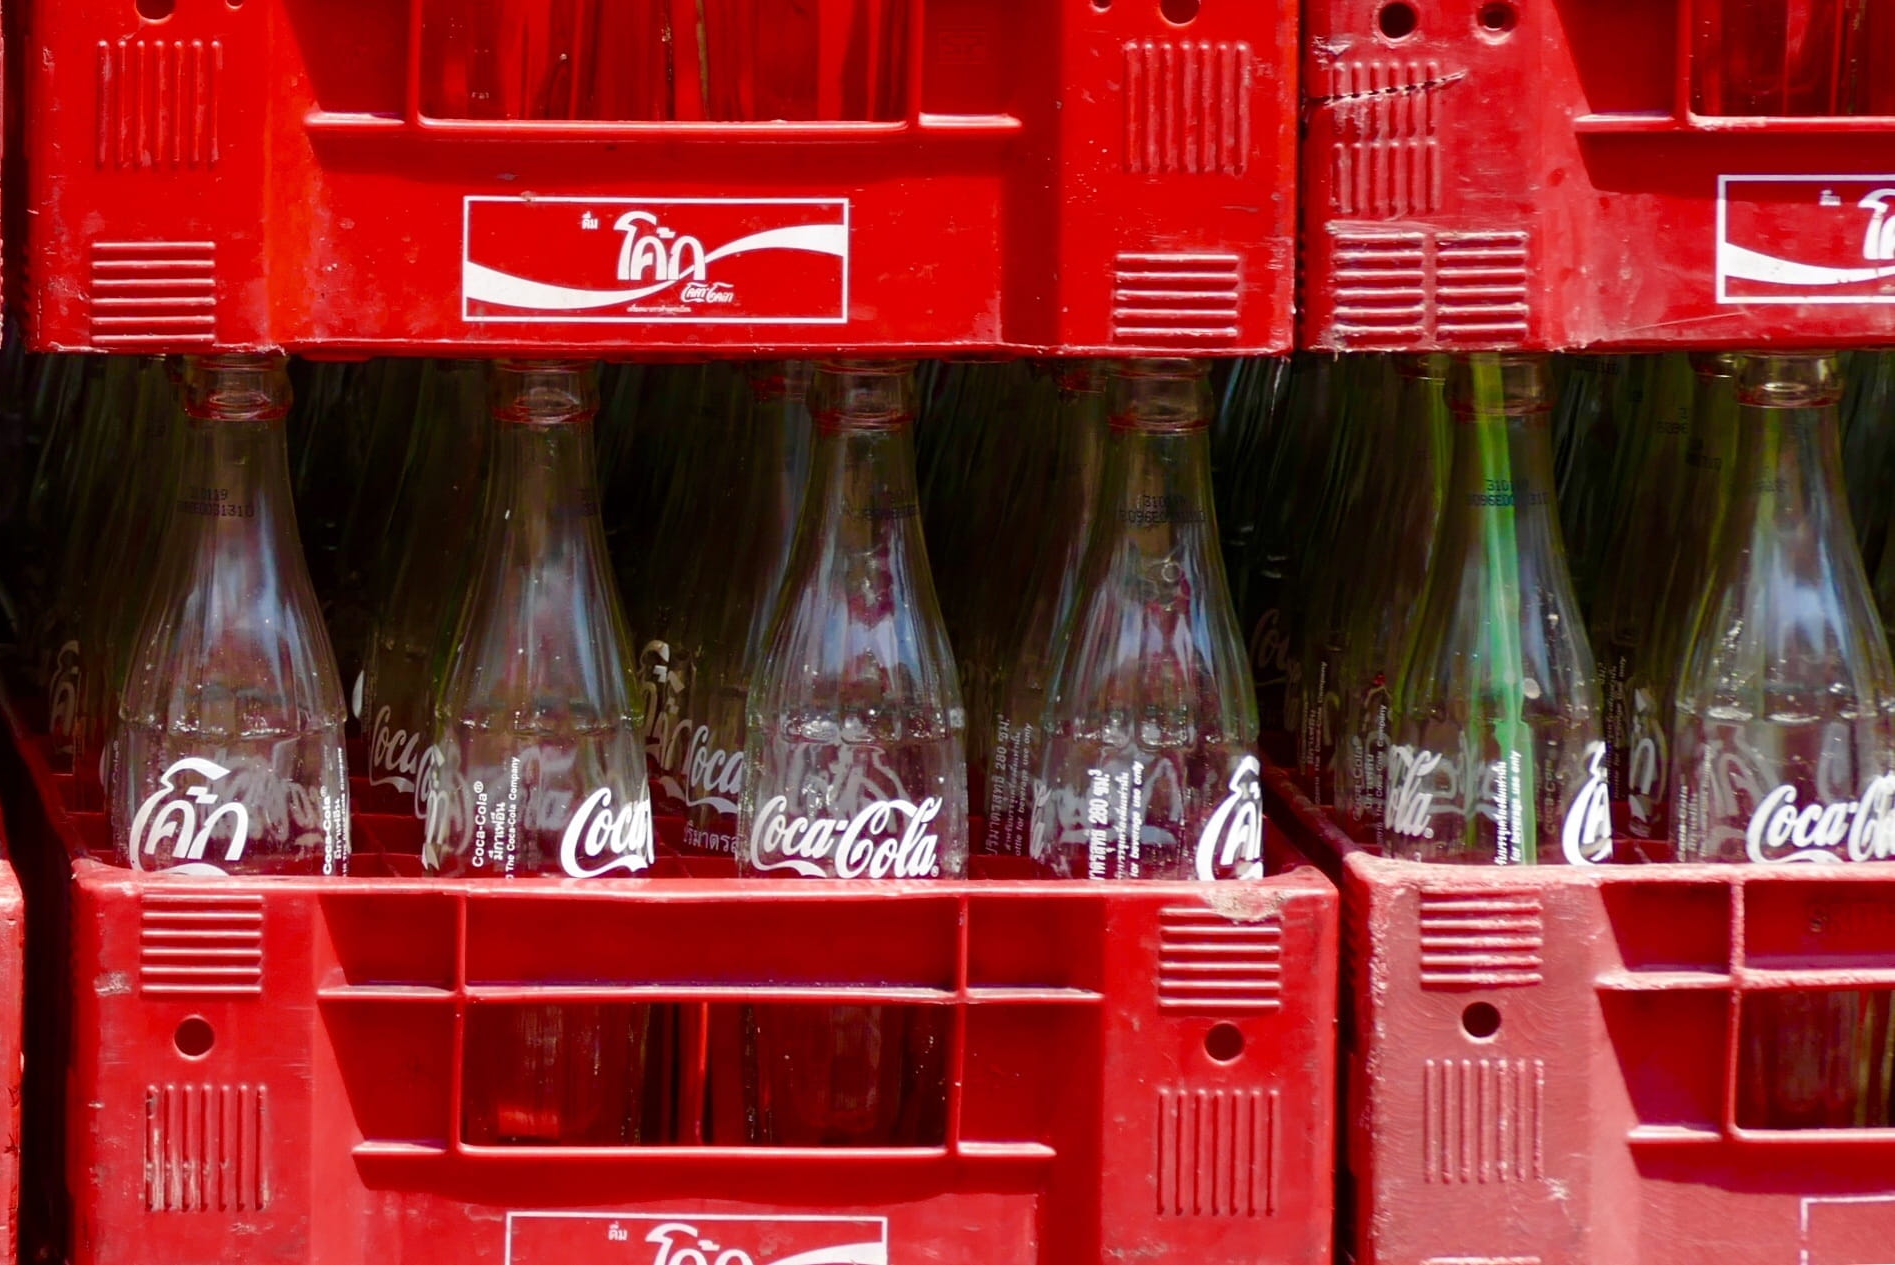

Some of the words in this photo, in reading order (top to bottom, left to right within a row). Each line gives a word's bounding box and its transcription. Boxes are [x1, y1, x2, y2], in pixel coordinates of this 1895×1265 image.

[613, 210, 706, 281] โค้ก
[1023, 722, 1034, 744] only
[995, 746, 1007, 770] 280
[1022, 747, 1030, 766] use
[1510, 749, 1522, 774] only
[509, 756, 520, 801] Company
[1132, 760, 1144, 785] only
[1511, 775, 1521, 795] use
[1016, 769, 1029, 813] beverage
[1132, 788, 1141, 808] use
[1015, 816, 1024, 831] for
[1089, 798, 1109, 825] 280
[1510, 797, 1522, 844] beverage
[472, 781, 488, 868] Coca-Cola®
[488, 802, 506, 861] มีกาเฟอีน
[507, 804, 517, 851] Coca-Cola
[1131, 811, 1142, 859] beverage
[506, 854, 514, 872] The
[1510, 846, 1522, 862] for
[1130, 862, 1140, 878] for
